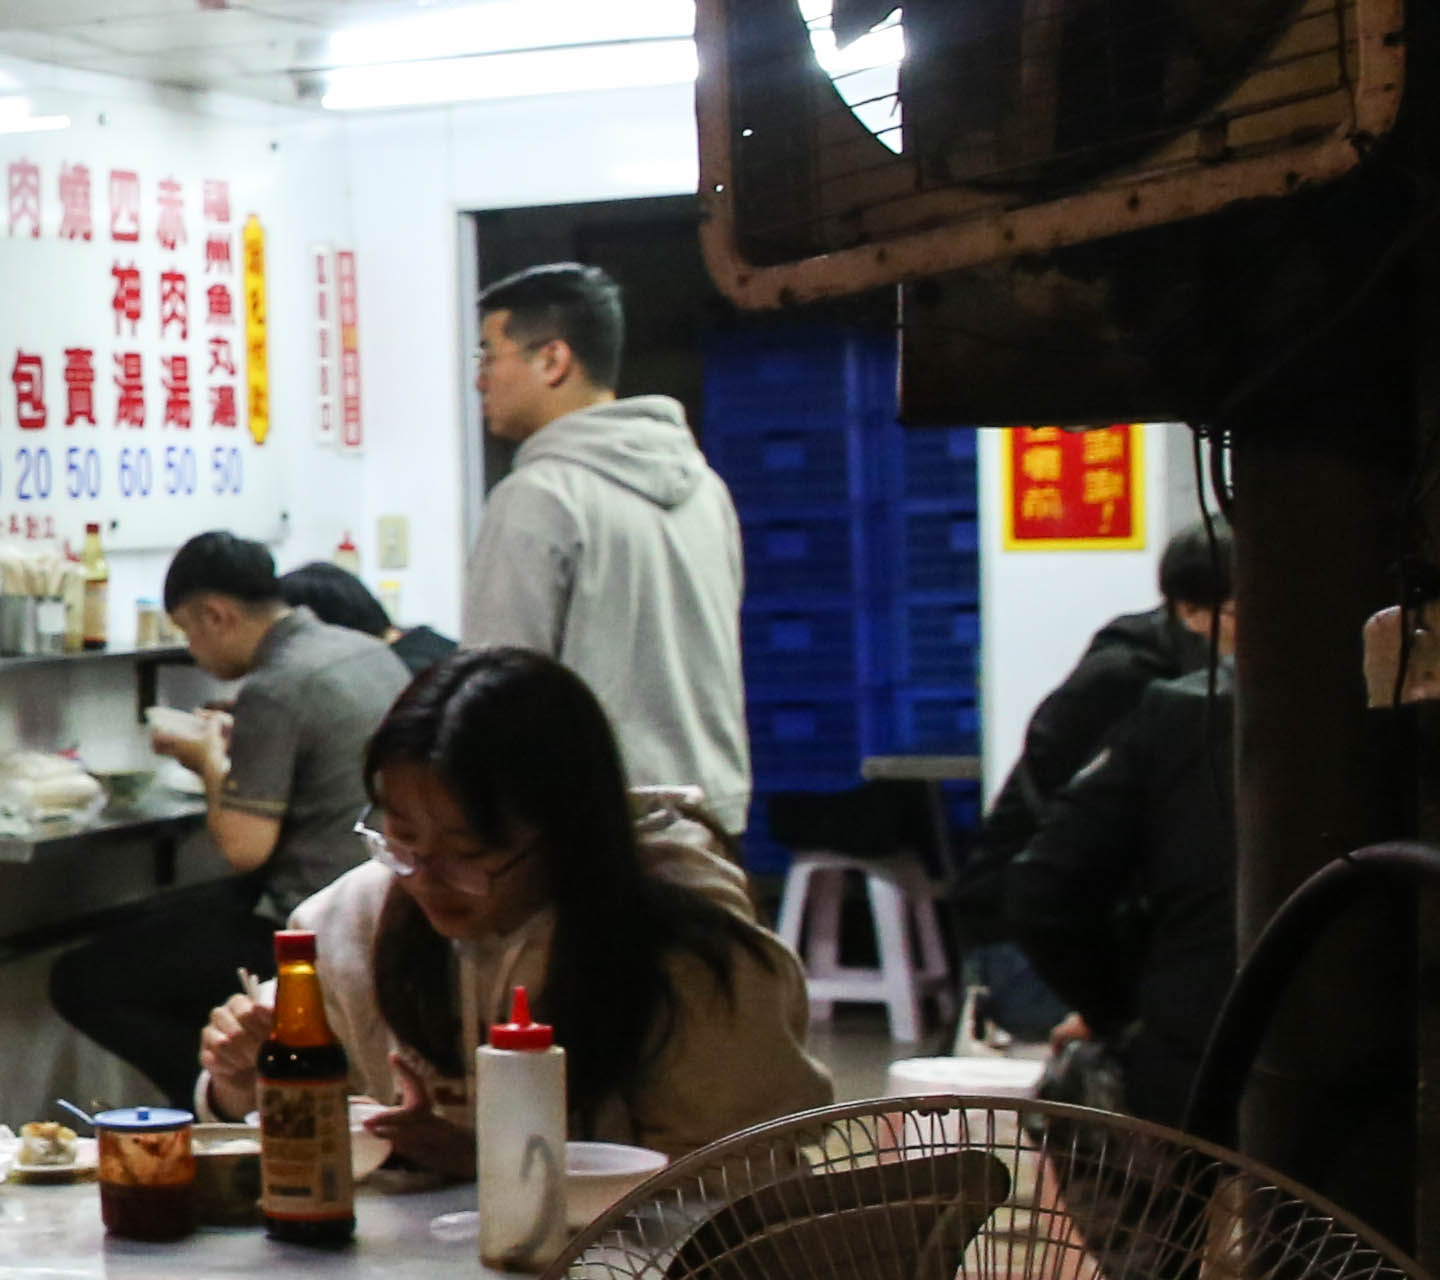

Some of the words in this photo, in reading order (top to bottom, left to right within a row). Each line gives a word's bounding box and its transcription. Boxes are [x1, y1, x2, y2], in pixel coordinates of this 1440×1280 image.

[7, 158, 46, 430] 肉包
[109, 168, 145, 428] 四神湯
[157, 174, 192, 428] 赤肉湯
[15, 447, 52, 500] 20
[66, 446, 101, 499] 50
[119, 446, 152, 498] 60
[166, 446, 197, 495] 50
[213, 446, 243, 495] 50
